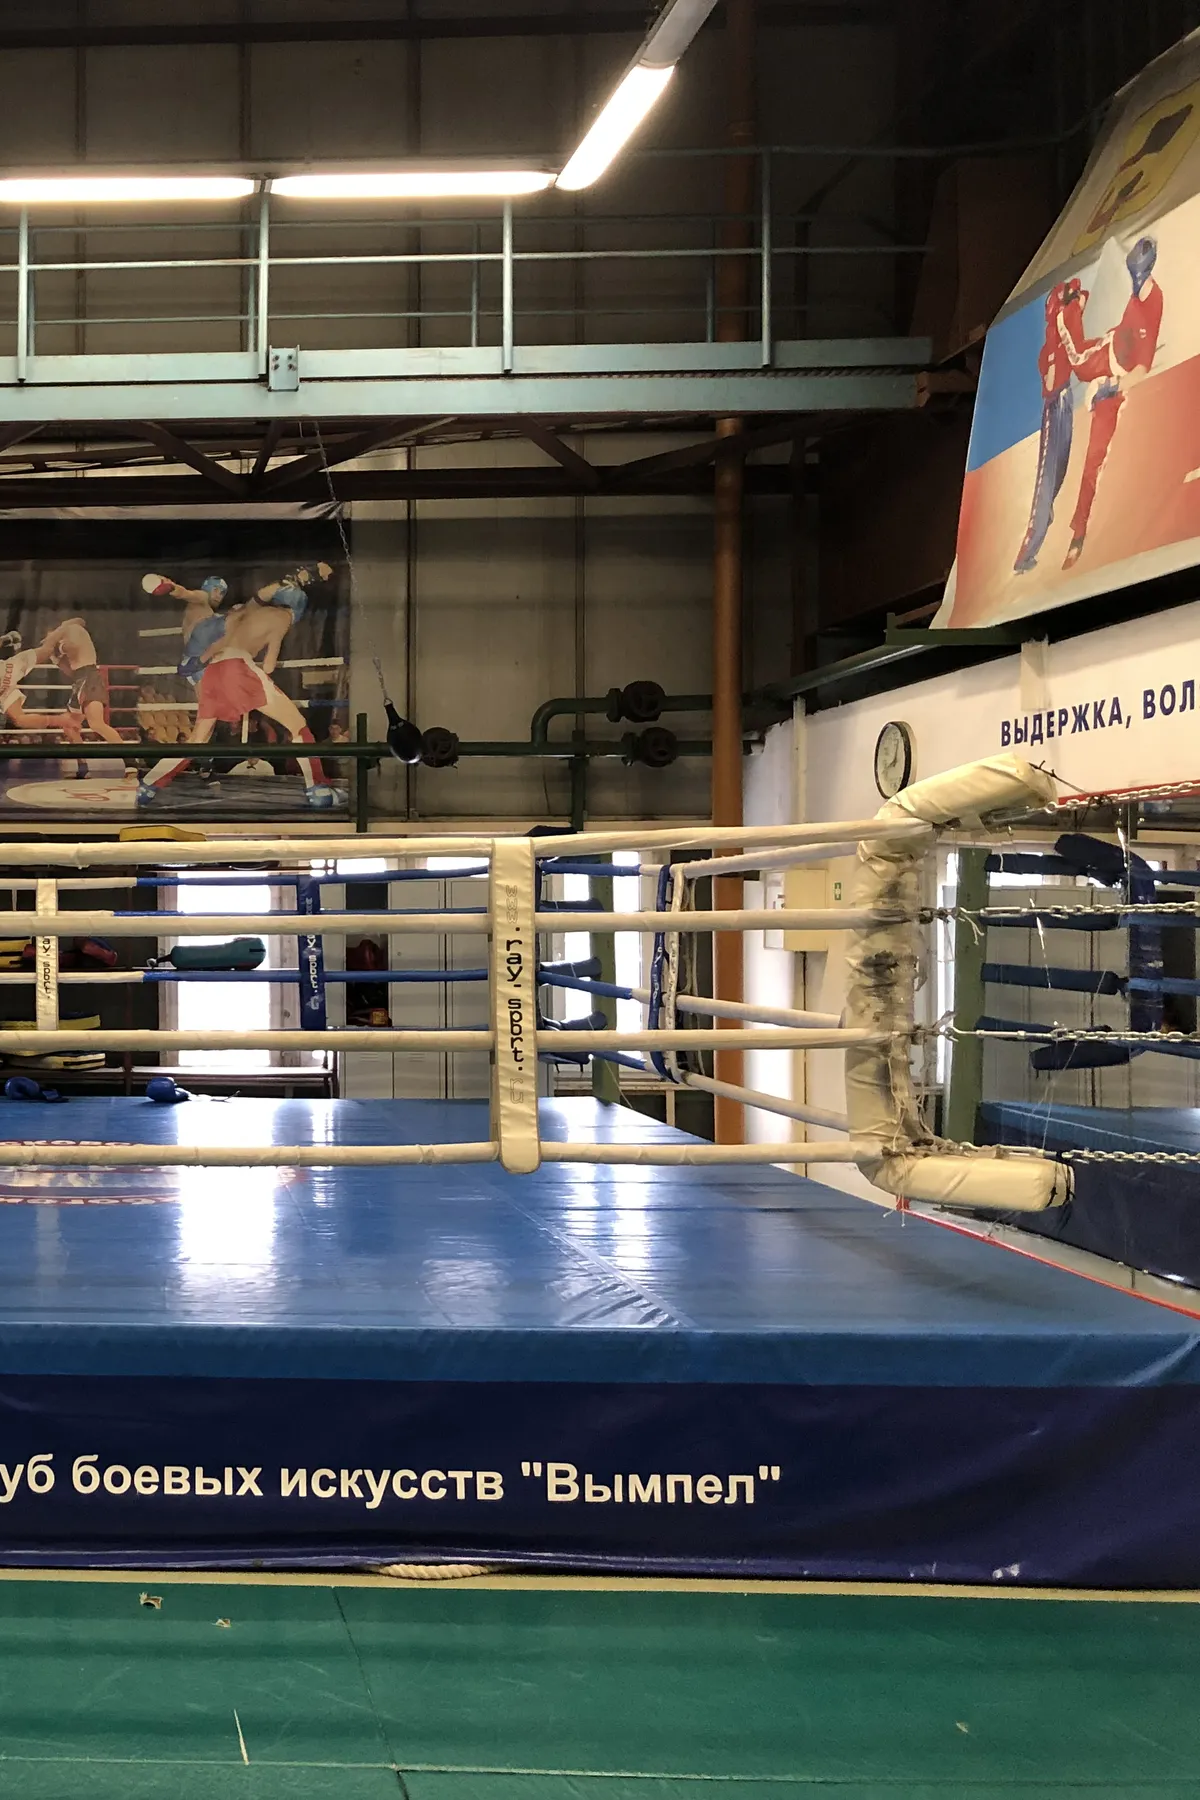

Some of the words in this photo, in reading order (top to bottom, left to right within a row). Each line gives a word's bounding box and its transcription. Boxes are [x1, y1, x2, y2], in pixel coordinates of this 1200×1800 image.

[1001, 696, 1132, 747] ВЫДЕРЖКА,
[1142, 678, 1200, 720] ВОЛ
[72, 1454, 264, 1497] боевых
[279, 1468, 504, 1510] искусств
[521, 1461, 782, 1505] "Вымпел"
